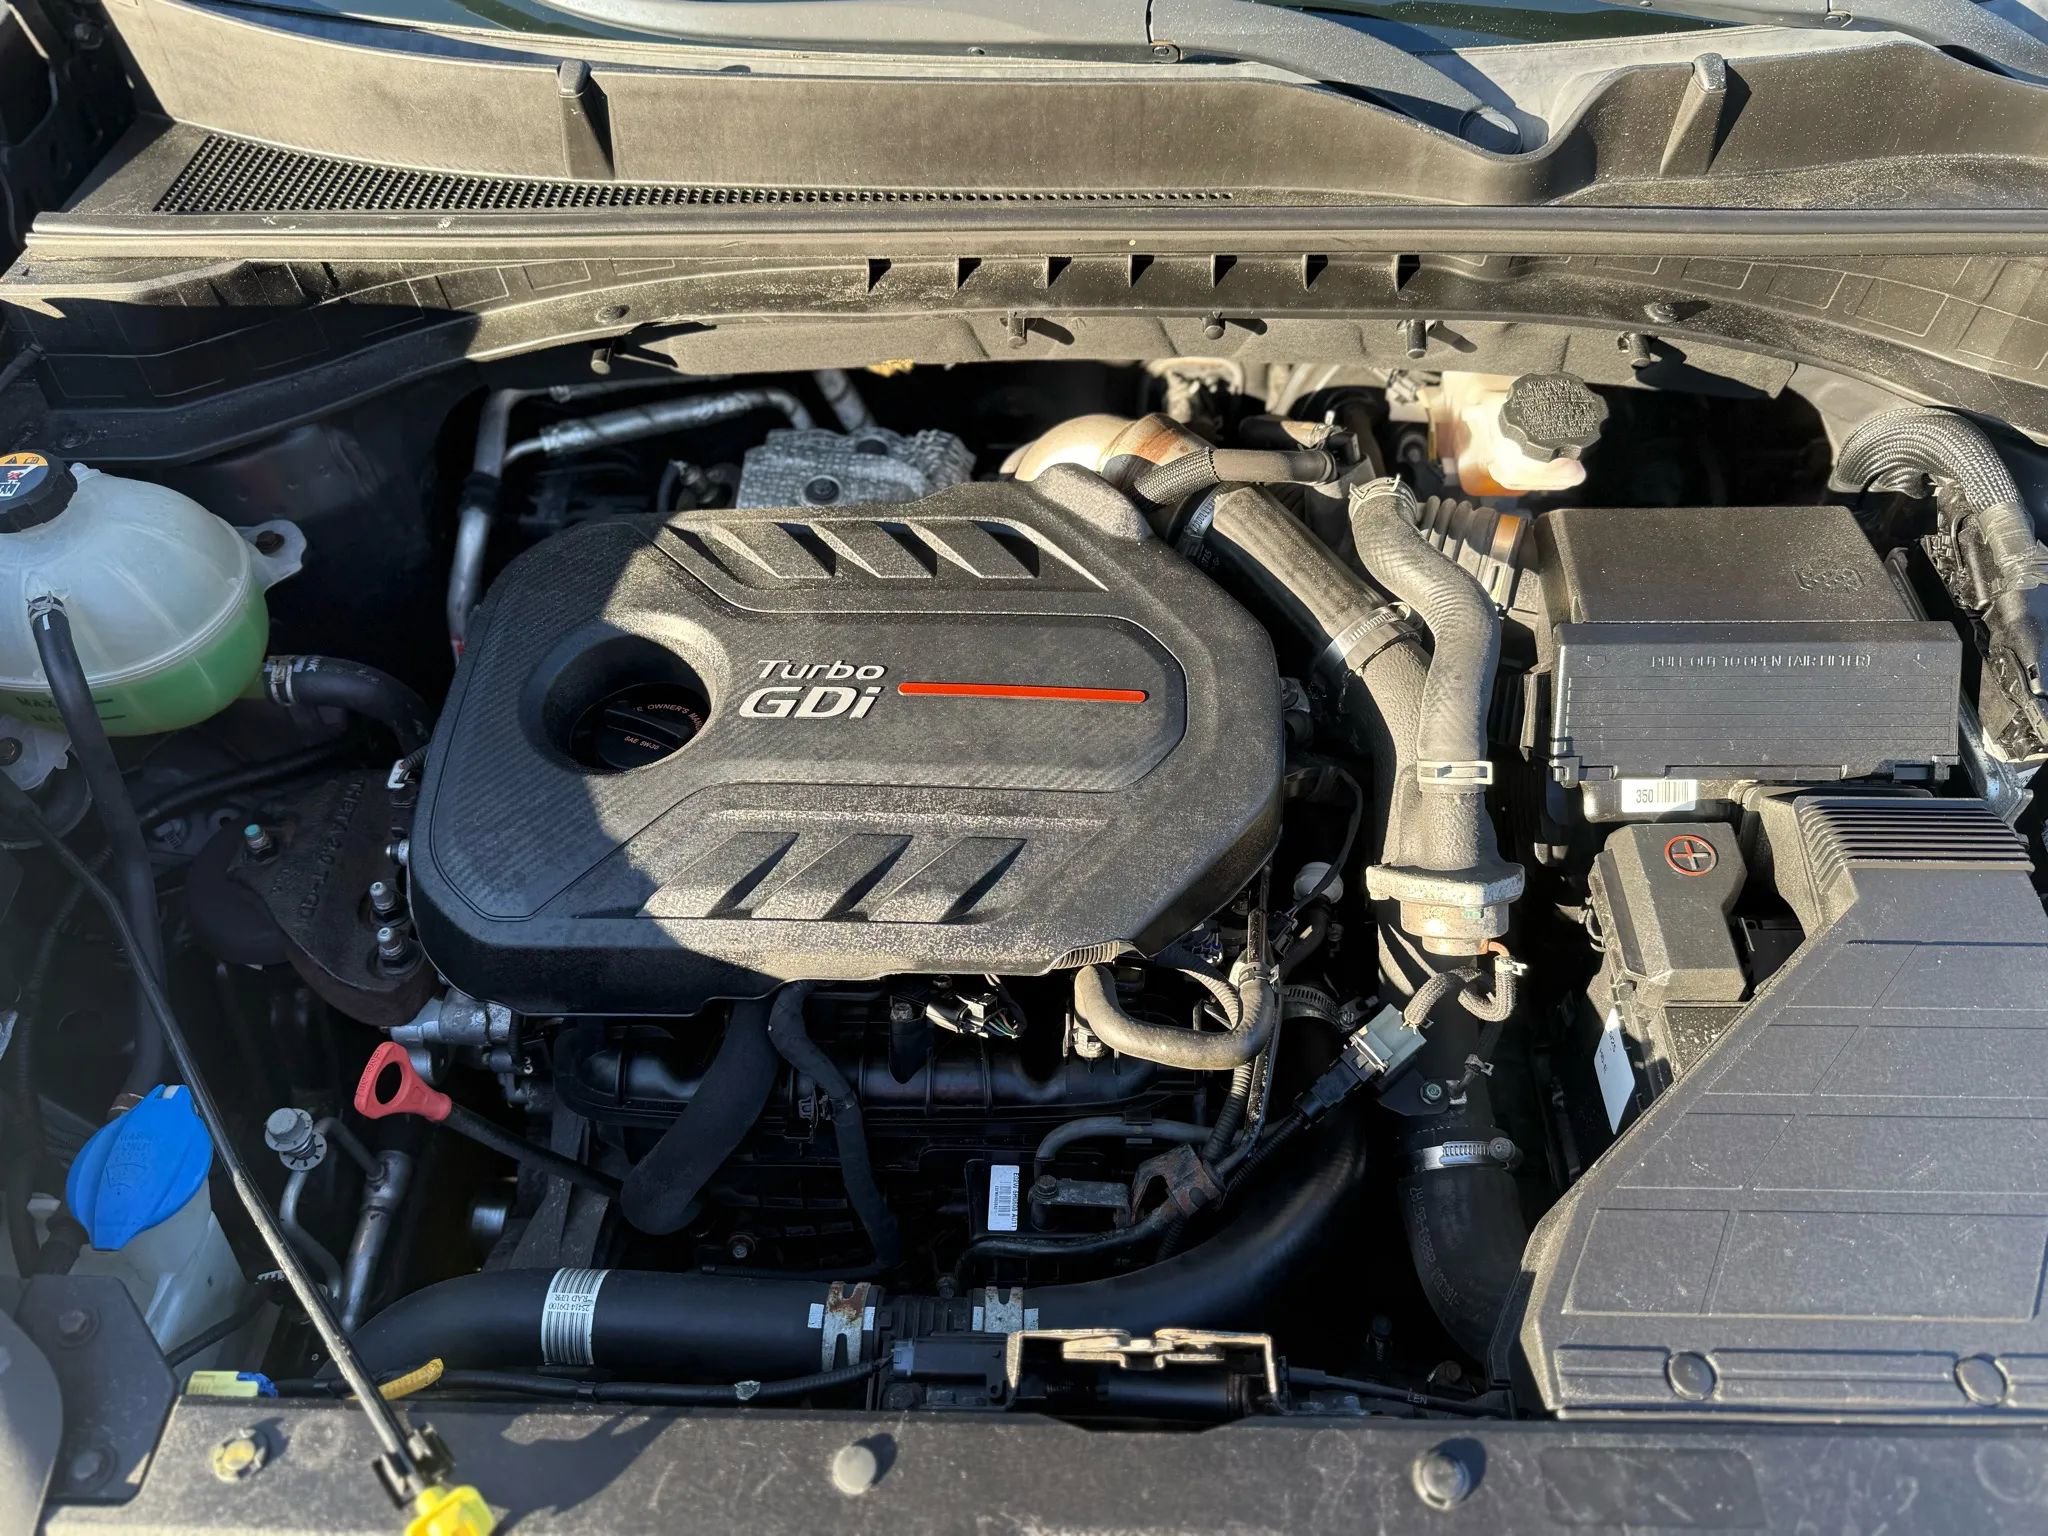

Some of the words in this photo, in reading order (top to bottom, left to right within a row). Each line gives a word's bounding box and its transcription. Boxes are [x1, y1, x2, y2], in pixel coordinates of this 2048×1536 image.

[1651, 655, 1684, 668] PULL
[1690, 655, 1716, 668] OUT
[1721, 655, 1740, 668] TO
[1743, 655, 1782, 668] OPEN
[757, 659, 887, 680] Turbo
[647, 703, 690, 715] OWNER'S
[739, 686, 884, 719] GDi
[1636, 789, 1654, 804] 350
[570, 1294, 589, 1303] RAD
